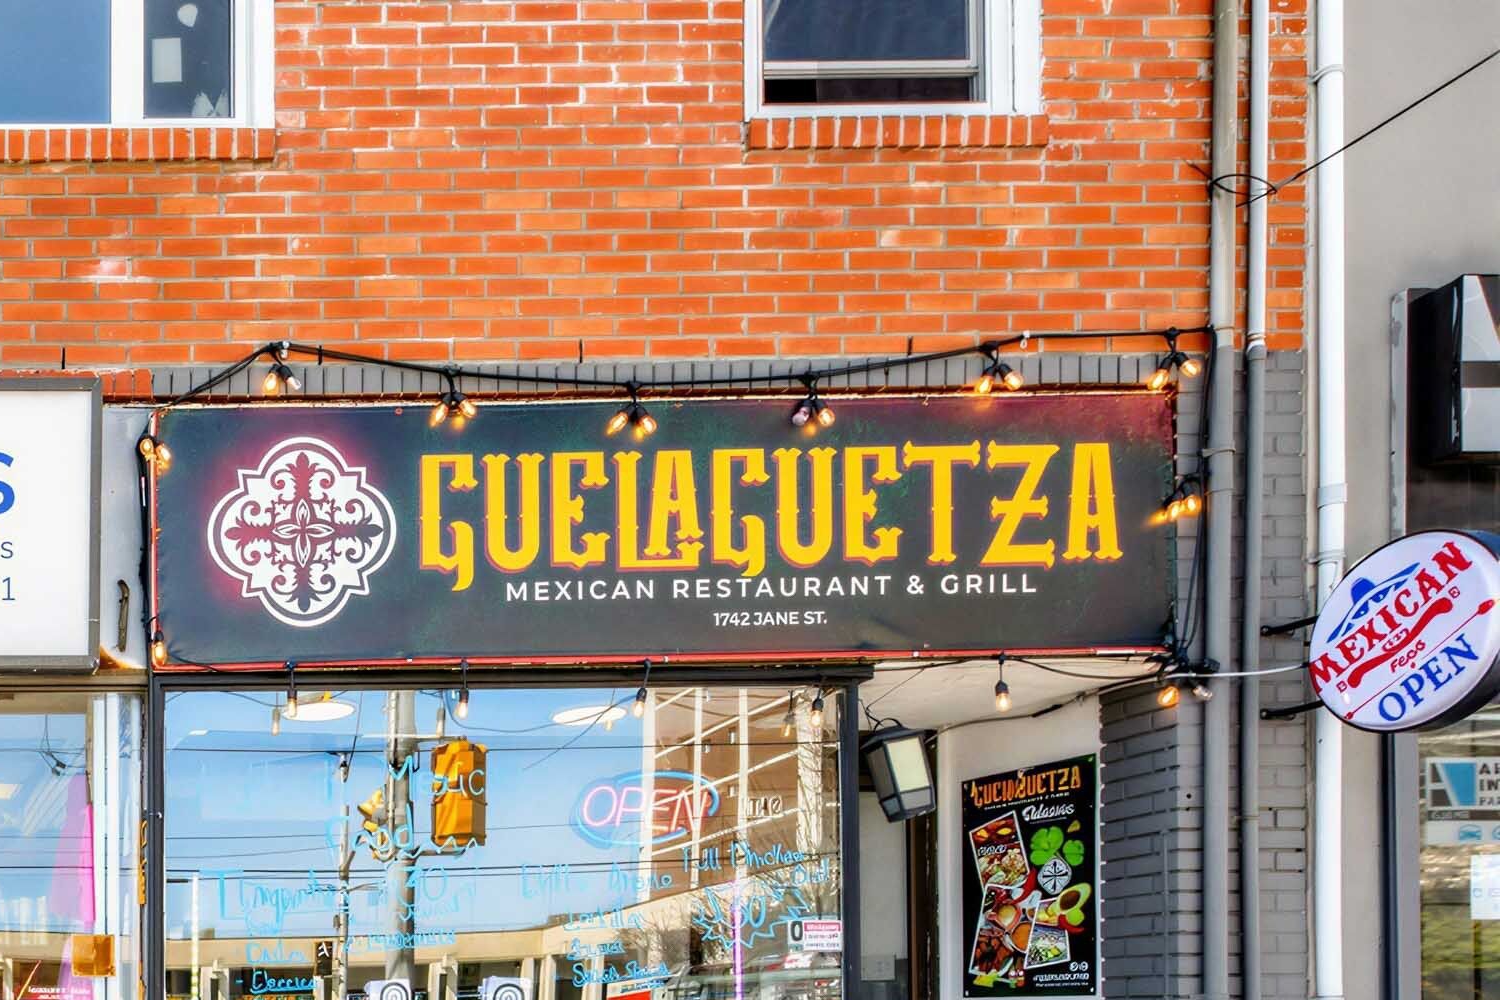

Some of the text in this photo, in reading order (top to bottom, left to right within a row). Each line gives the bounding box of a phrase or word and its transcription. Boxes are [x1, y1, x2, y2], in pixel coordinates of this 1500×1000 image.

[419, 441, 1123, 590] GUELAGUETZA
[505, 573, 1037, 602] MEXICAN RESTAURANT & GRILL
[713, 610, 828, 627] 1742 JANE ST.
[1308, 541, 1473, 694] MEXICAN
[1378, 633, 1479, 722] OPEN
[582, 786, 711, 834] OPEN
